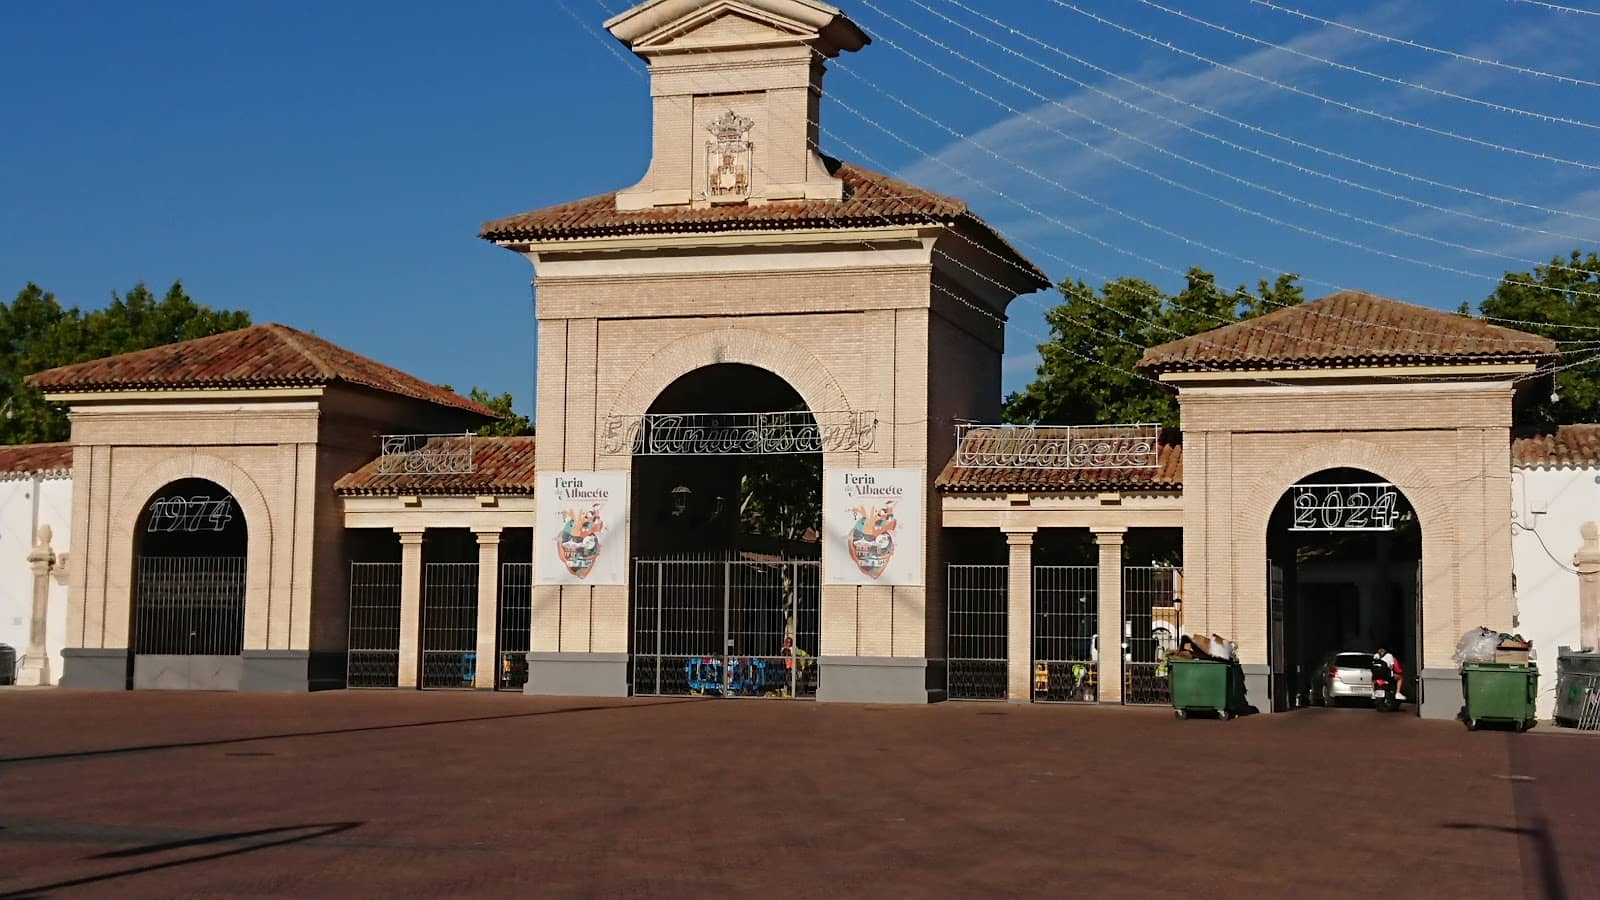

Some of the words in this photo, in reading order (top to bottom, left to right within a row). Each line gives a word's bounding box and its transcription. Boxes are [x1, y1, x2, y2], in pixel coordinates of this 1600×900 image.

[603, 419, 642, 453] 50
[651, 416, 875, 453] Aniversario
[959, 427, 1151, 467] Albacete
[379, 437, 478, 473] Feria
[555, 477, 583, 488] Feria
[844, 473, 875, 484] Feria
[147, 495, 232, 532] 1974
[1295, 490, 1399, 529] 2024
